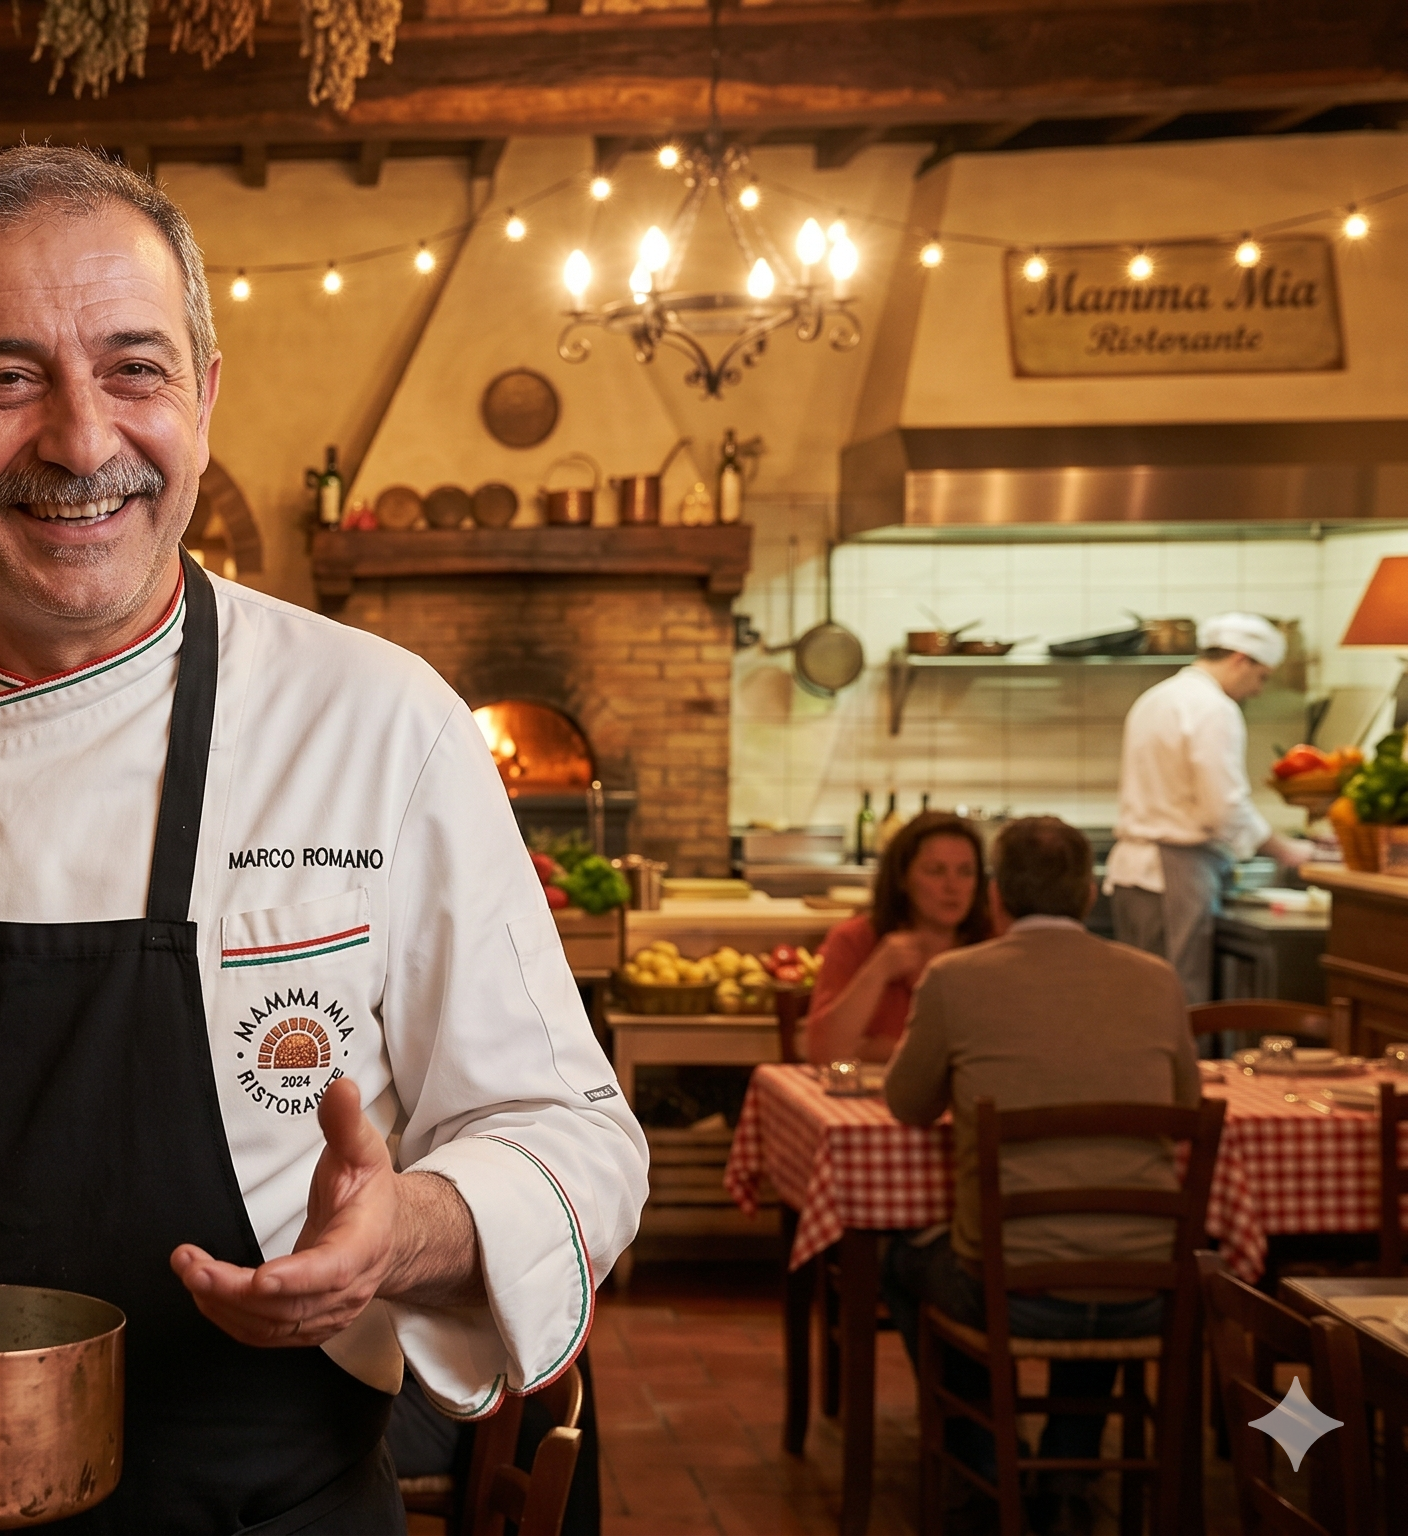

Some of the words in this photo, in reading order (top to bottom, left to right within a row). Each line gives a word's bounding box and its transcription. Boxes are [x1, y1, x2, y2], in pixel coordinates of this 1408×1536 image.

[1024, 271, 1211, 316] Mamma
[1224, 266, 1318, 310] Mia
[1084, 321, 1263, 357] Ristorante
[228, 848, 294, 870] MARCO
[302, 847, 384, 870] ROMANO
[233, 987, 319, 1044] MAMMA
[323, 999, 355, 1043] MIA
[280, 1075, 311, 1088] 2024
